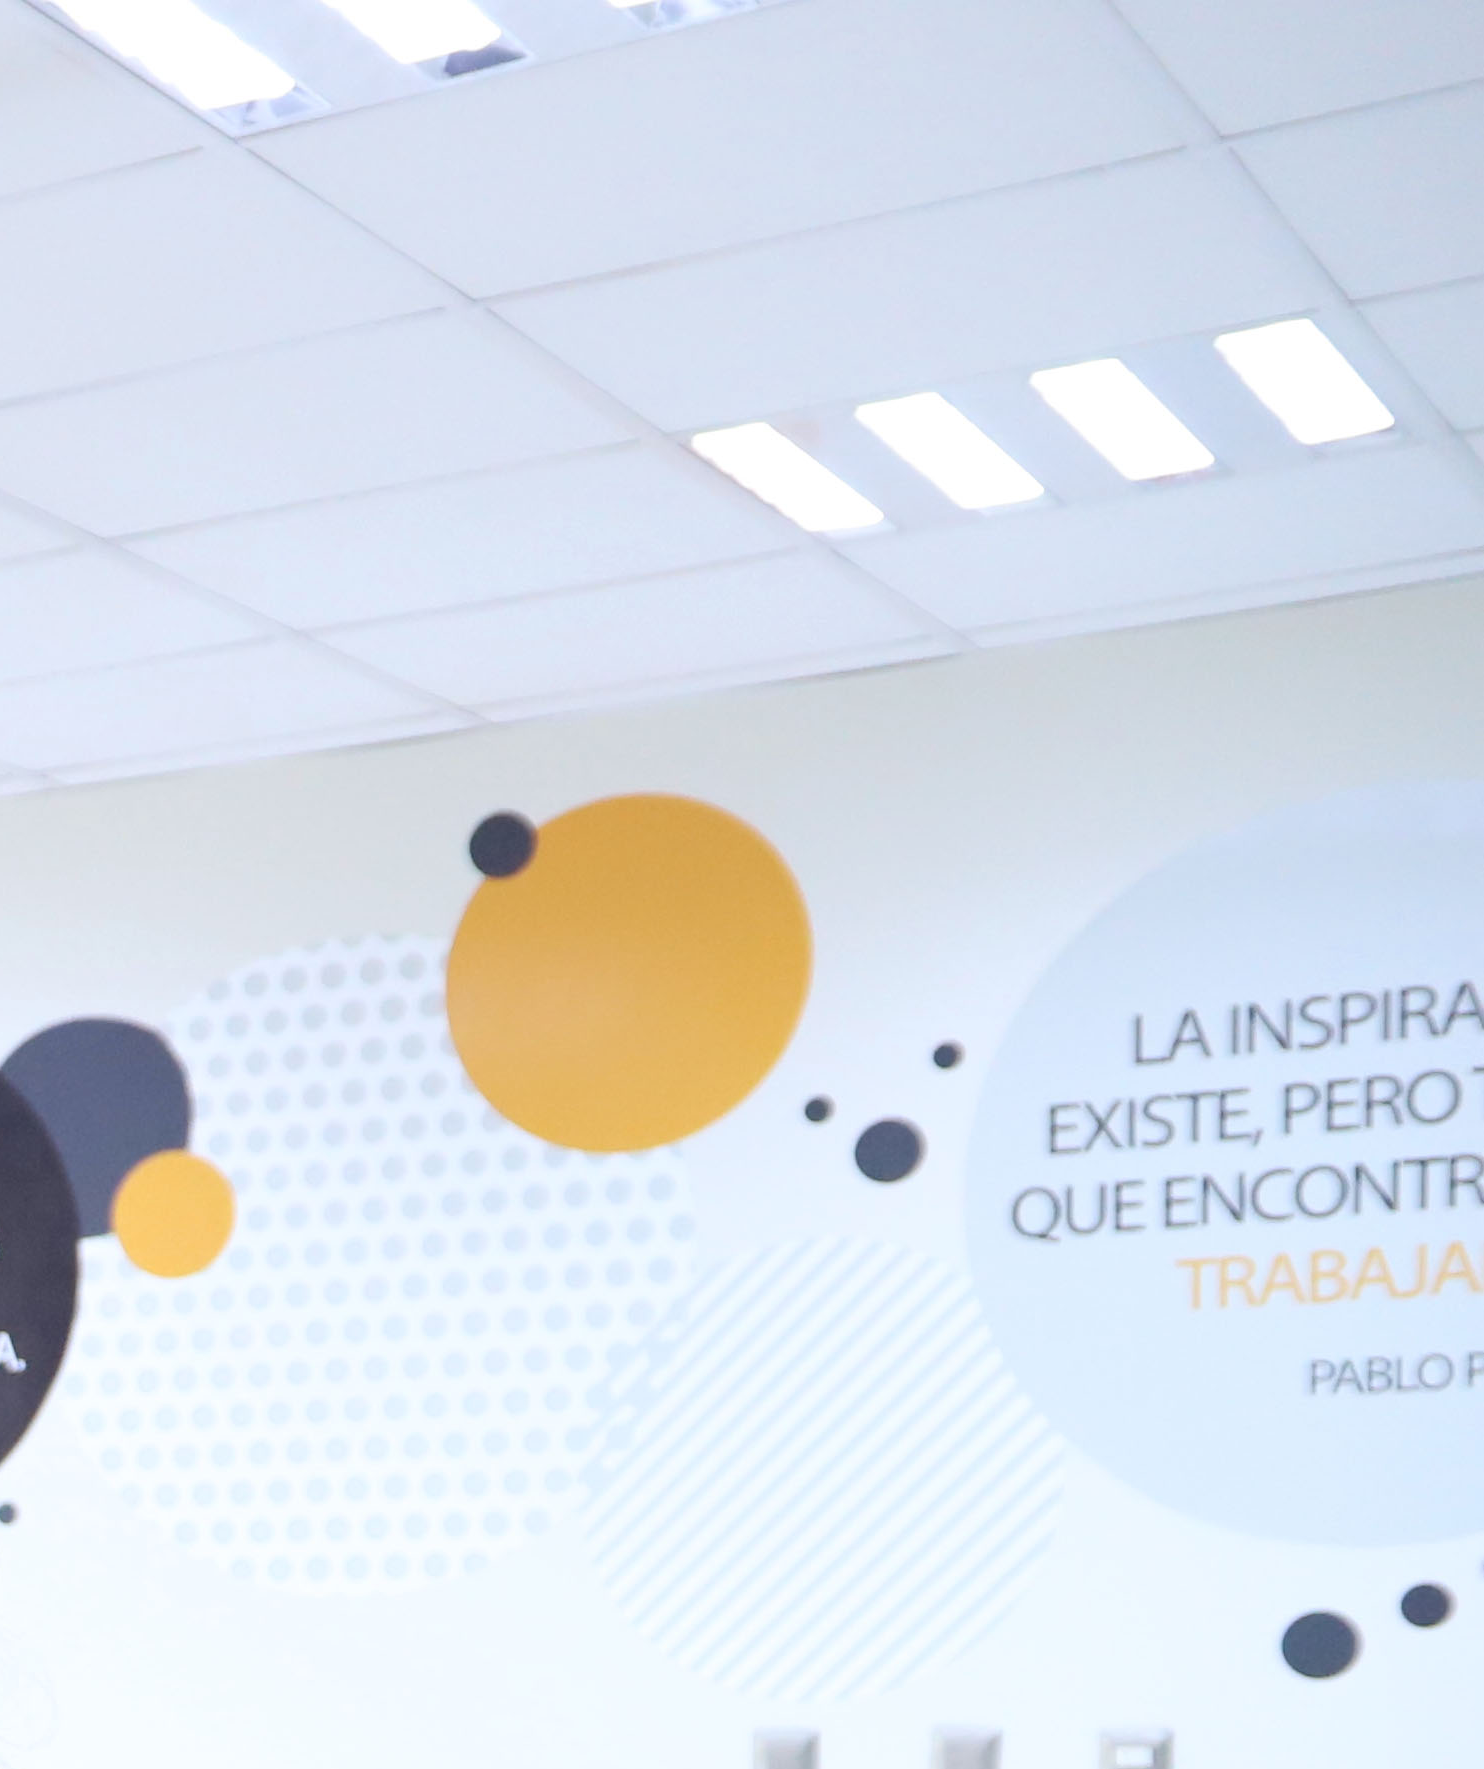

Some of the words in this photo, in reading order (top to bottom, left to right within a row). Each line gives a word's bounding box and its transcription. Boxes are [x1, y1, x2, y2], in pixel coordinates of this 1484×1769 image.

[1132, 1008, 1213, 1065] LA
[1231, 980, 1484, 1056] INSPIRA
[1048, 1087, 1264, 1155] EXISTE,
[1283, 1069, 1463, 1139] PERO
[1011, 1180, 1147, 1243] QUE
[1163, 1154, 1484, 1229] ENCONTR
[1175, 1241, 1484, 1311] TRABAJA
[1309, 1352, 1454, 1396] PABLO
